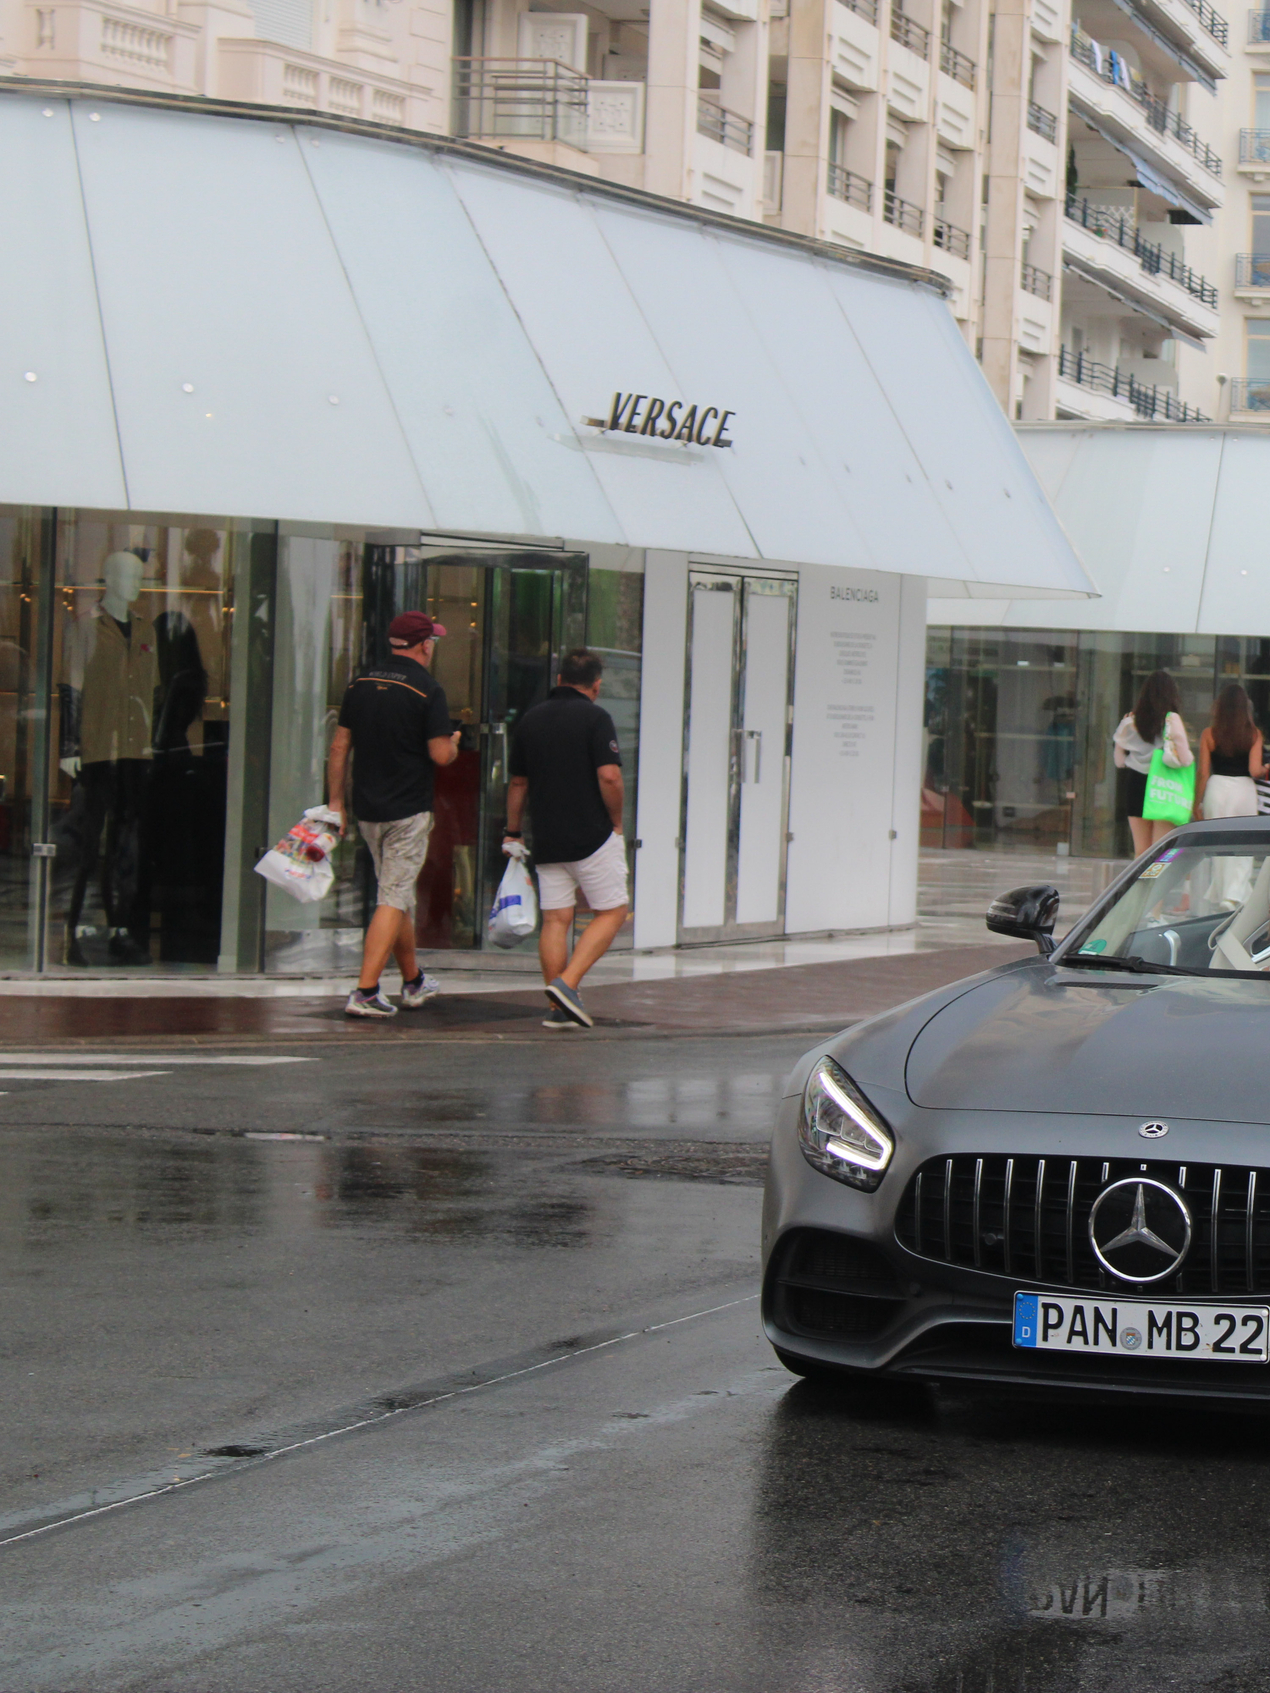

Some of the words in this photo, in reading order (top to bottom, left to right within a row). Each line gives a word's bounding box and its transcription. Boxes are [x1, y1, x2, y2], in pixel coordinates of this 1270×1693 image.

[607, 391, 737, 449] VERSACE
[830, 585, 879, 603] BALENCIAGA
[1150, 774, 1184, 794] FROM
[1021, 1325, 1031, 1338] D
[1040, 1301, 1119, 1348] PAN
[1147, 1309, 1202, 1352] MB
[1211, 1312, 1265, 1355] 22
